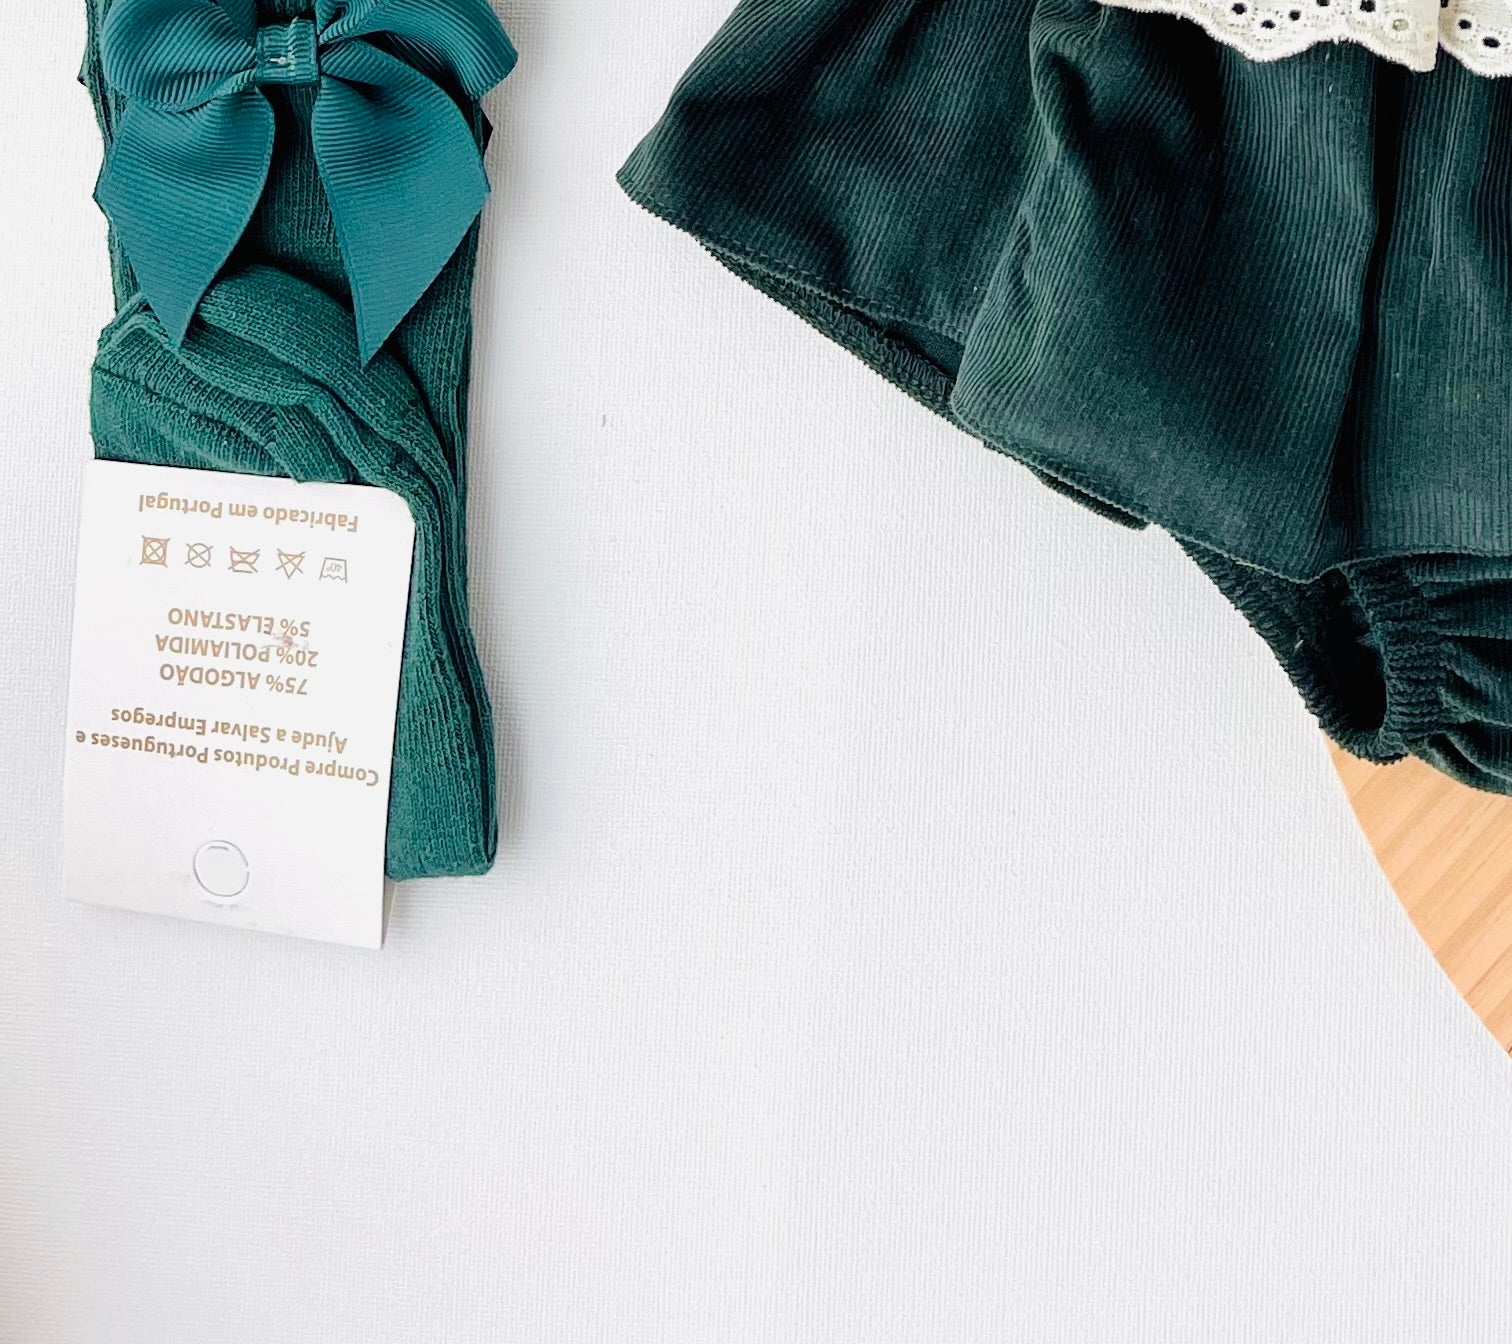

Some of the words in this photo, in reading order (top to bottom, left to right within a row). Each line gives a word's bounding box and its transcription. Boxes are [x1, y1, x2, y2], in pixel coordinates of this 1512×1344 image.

[139, 492, 222, 518] Portugal
[229, 503, 258, 517] em
[263, 507, 358, 532] Fabricado
[168, 608, 274, 635] ELASTANO
[280, 618, 311, 637] 5%
[155, 634, 270, 662] POLIAMIDA
[276, 646, 318, 667] 20%
[160, 664, 261, 690] ALGODÃO
[266, 675, 307, 695] 75%
[112, 707, 206, 736] Empregos
[211, 721, 271, 743] Salvar
[76, 731, 86, 743] e
[276, 728, 287, 741] a
[291, 731, 347, 754] Ajude
[91, 733, 208, 764] Portugueses
[214, 749, 300, 776] Produtos
[305, 760, 379, 786] Compre
